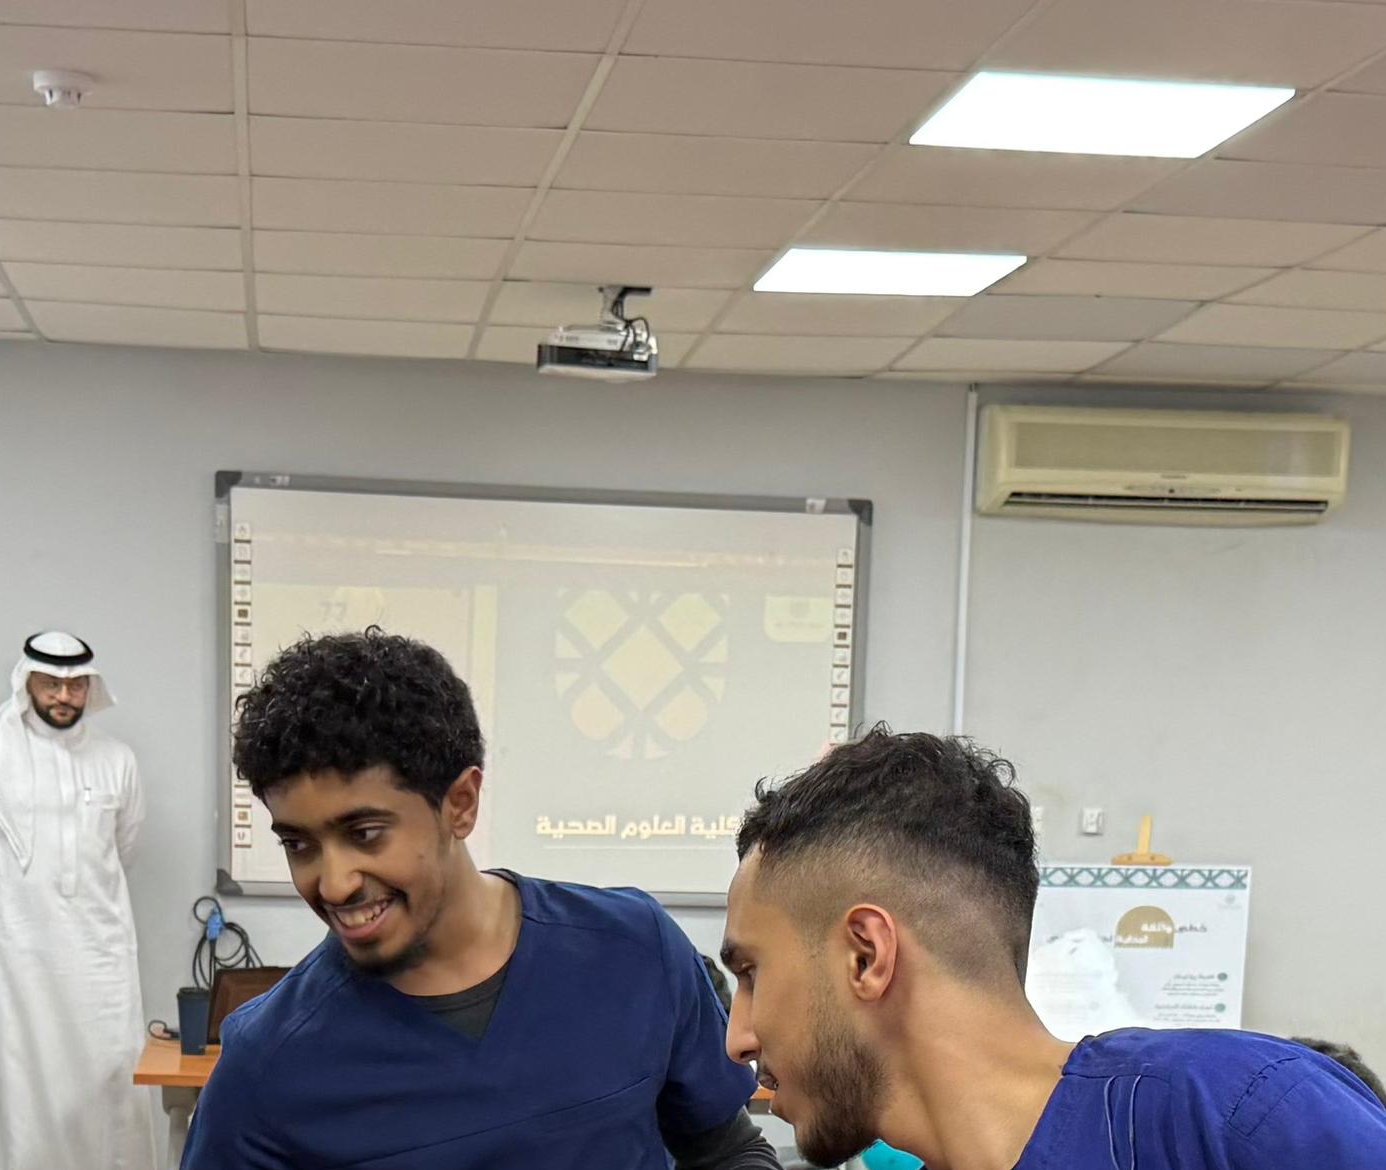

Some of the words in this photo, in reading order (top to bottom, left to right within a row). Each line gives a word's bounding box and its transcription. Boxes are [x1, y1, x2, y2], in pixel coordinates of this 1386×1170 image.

[536, 814, 616, 839] الصحية
[620, 813, 685, 839] العلوم
[690, 814, 741, 839] كلية
